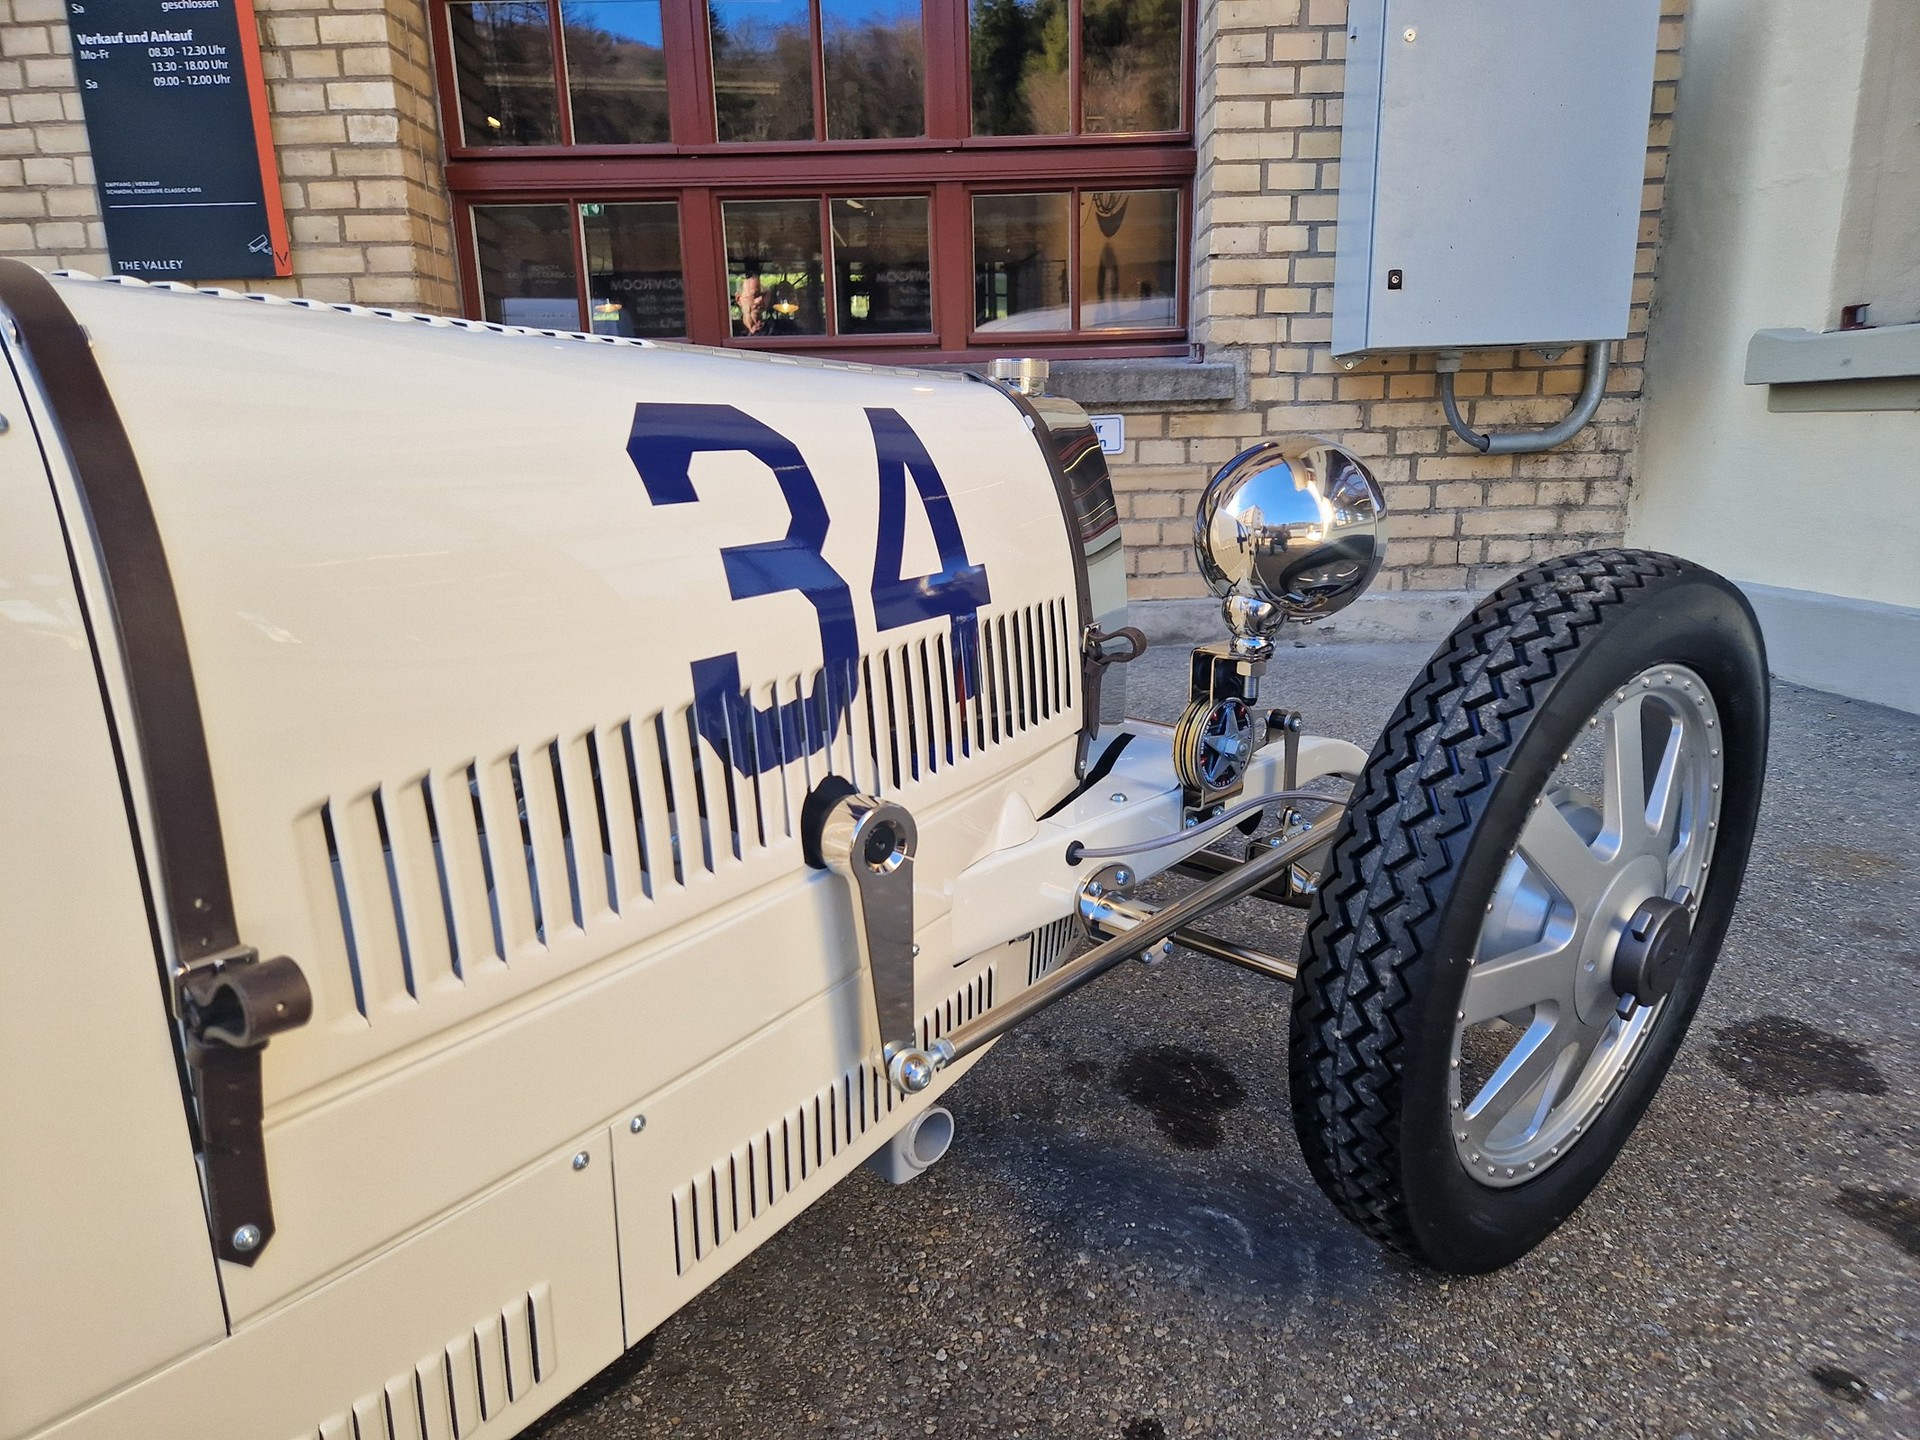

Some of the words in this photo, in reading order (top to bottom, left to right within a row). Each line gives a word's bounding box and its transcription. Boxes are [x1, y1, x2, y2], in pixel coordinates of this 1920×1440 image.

[71, 3, 85, 14] Sa
[161, 0, 219, 12] geschlossen
[76, 32, 124, 45] Verkauf
[124, 31, 148, 43] und
[150, 29, 193, 42] Ankauf
[80, 49, 110, 60] Mo-Fr
[148, 47, 175, 57] 08.30
[181, 45, 207, 56] 12.30
[208, 44, 226, 55] Uhr
[151, 61, 177, 72] 13.30
[184, 60, 210, 71] 18.00
[211, 59, 229, 70] Uhr
[85, 79, 98, 89] Sa
[153, 76, 180, 87] 09.00
[187, 75, 212, 85] 12.00
[212, 73, 231, 84] Uhr
[118, 261, 141, 270] THE
[142, 260, 184, 270] VALLEY
[626, 402, 991, 779] 34
